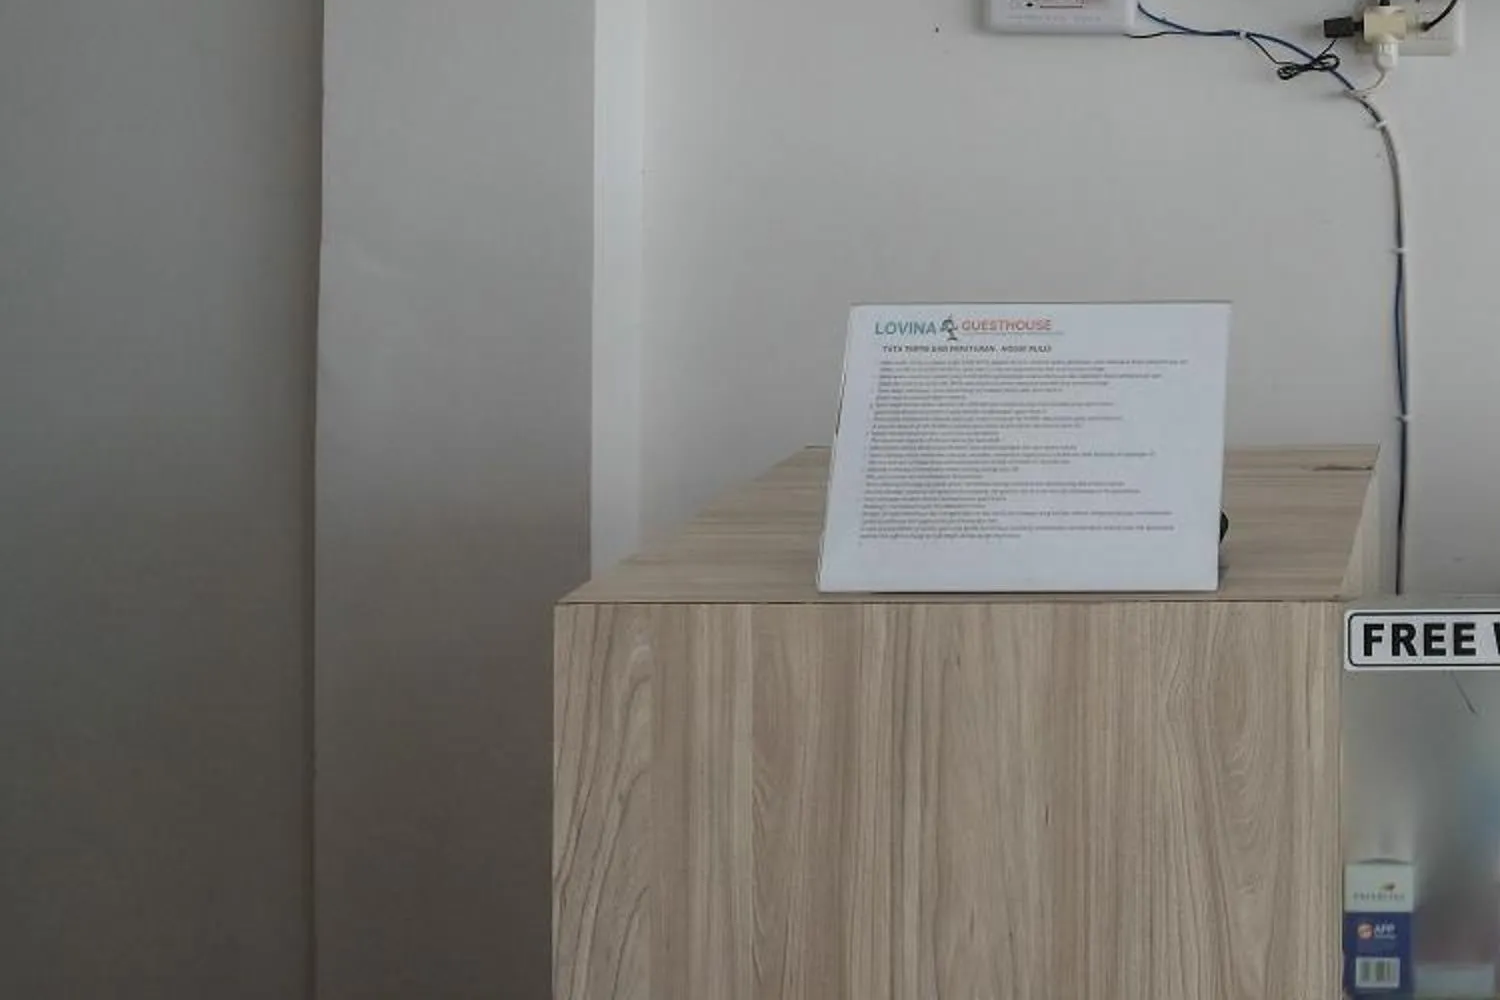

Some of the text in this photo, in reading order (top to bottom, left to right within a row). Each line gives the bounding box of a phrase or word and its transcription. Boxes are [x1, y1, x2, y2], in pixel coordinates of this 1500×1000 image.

[875, 318, 1052, 336] LOVINA GUESTHOUSE
[1363, 622, 1477, 657] FREE
